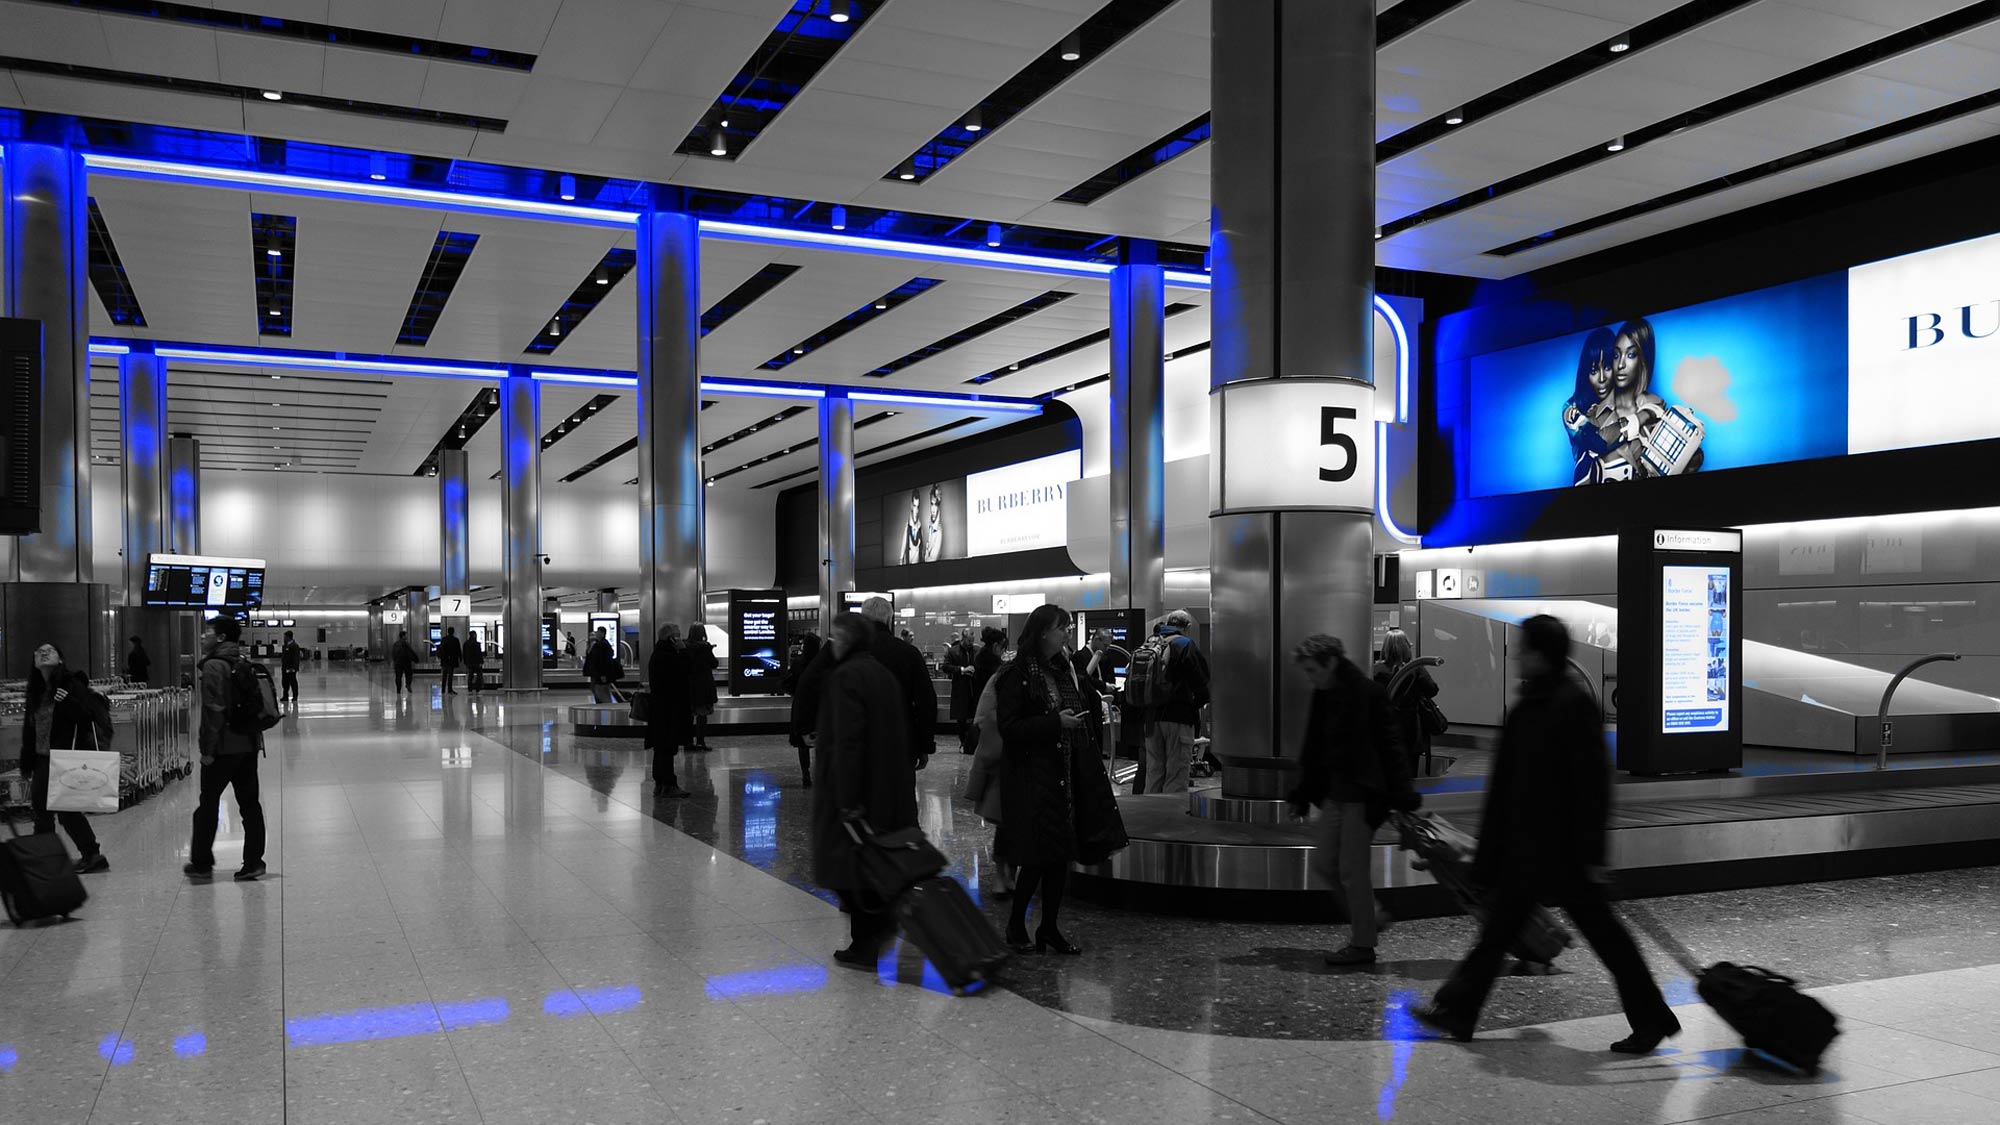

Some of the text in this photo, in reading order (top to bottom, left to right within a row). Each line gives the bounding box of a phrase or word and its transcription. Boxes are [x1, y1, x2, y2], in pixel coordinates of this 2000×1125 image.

[1318, 406, 1358, 482] 5
[977, 484, 1063, 514] BURBERRY
[1667, 535, 1712, 545] Information
[452, 599, 462, 612] 7
[391, 612, 397, 622] 9
